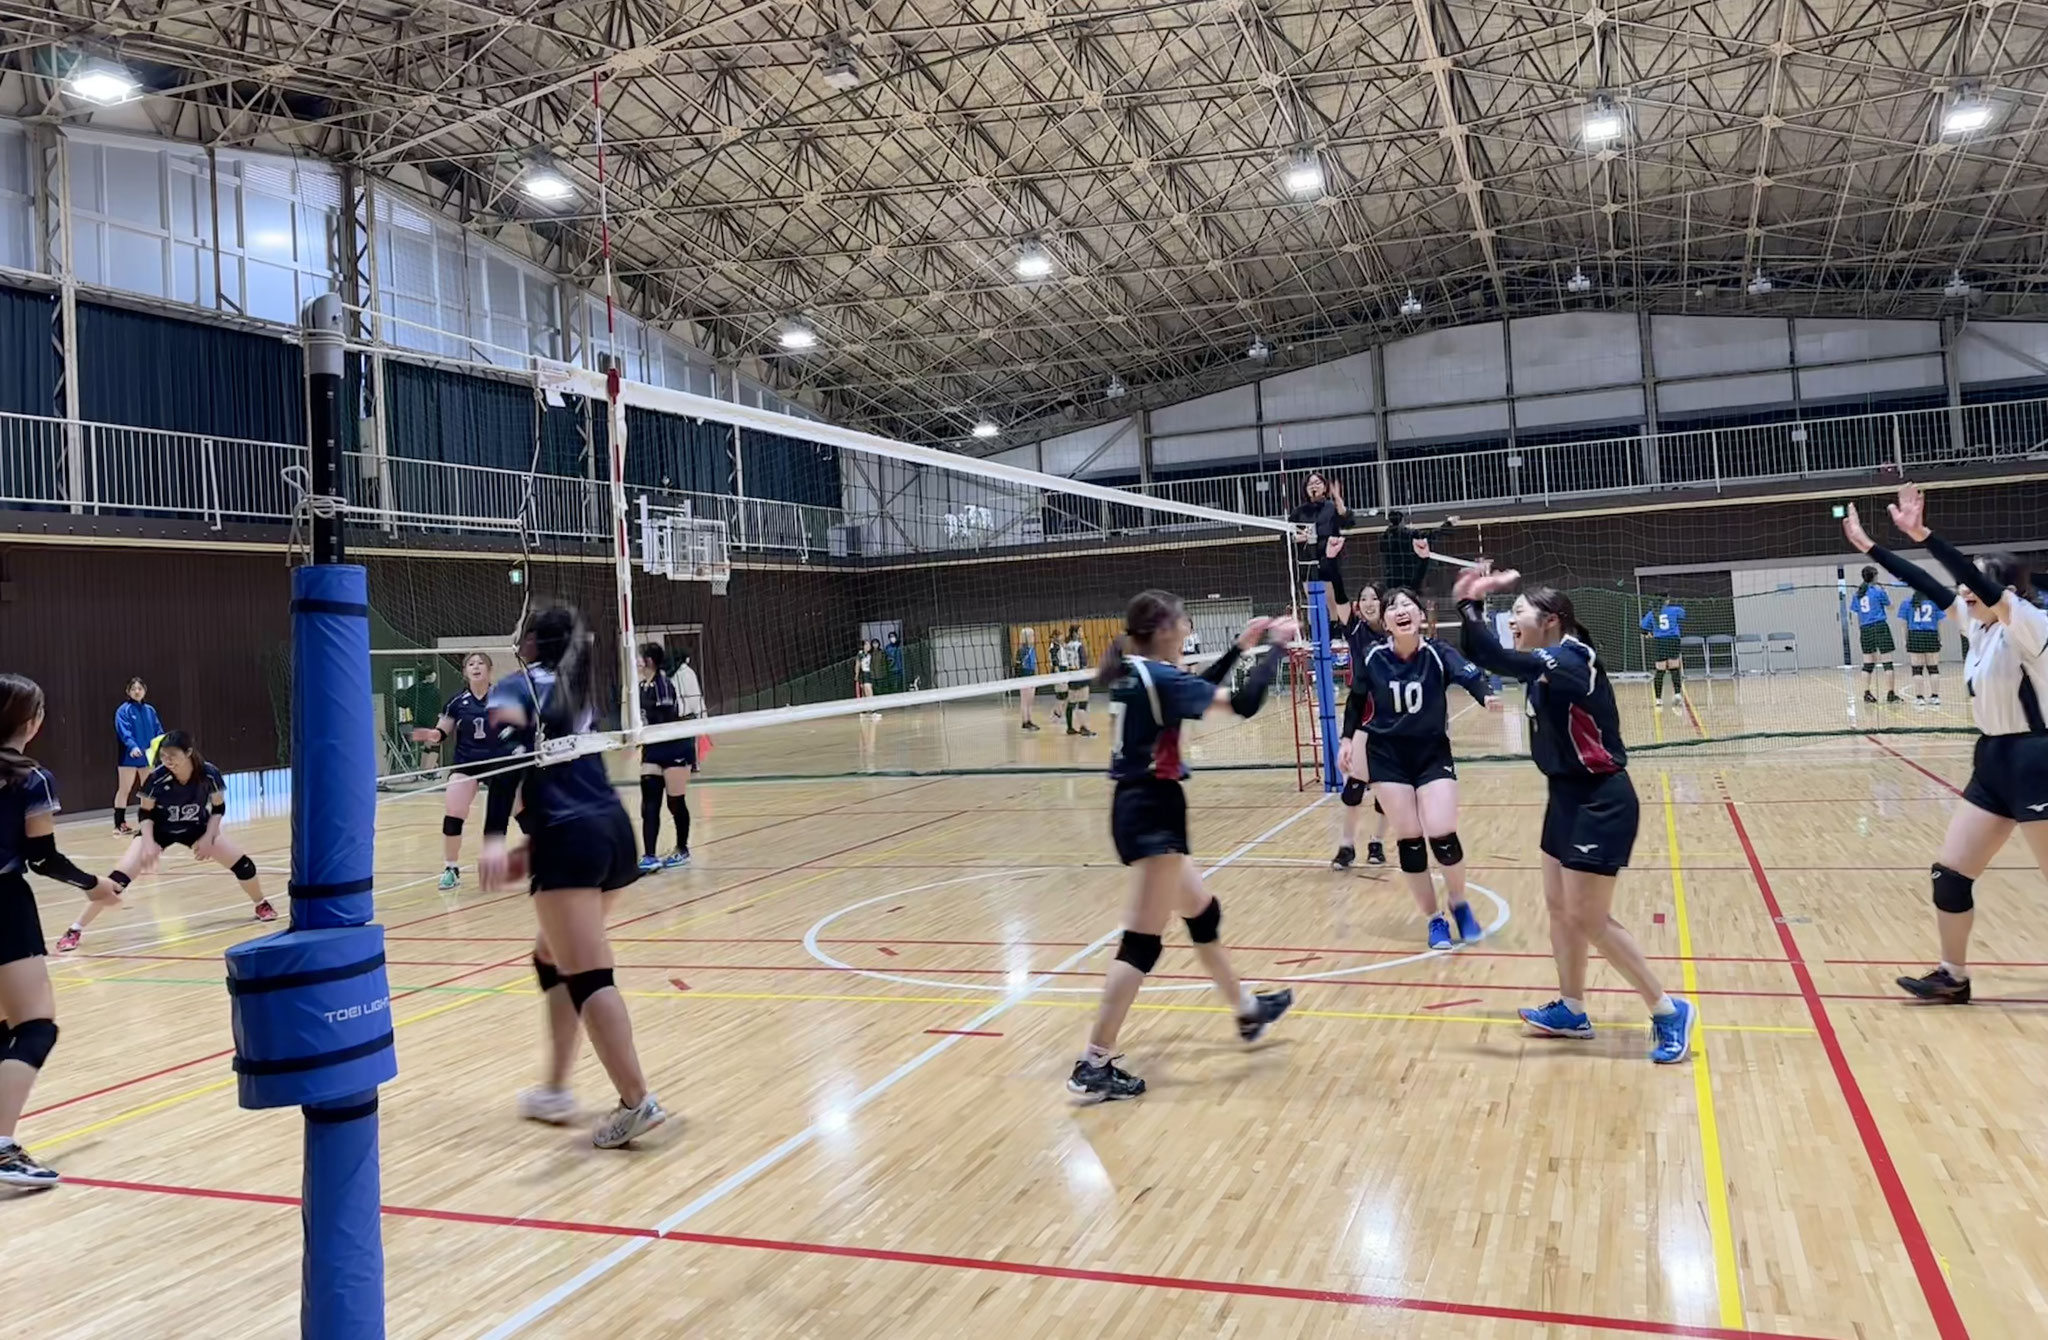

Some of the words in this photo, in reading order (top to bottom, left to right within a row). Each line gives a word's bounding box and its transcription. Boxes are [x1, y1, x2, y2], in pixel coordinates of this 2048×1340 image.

[1860, 595, 1870, 613] 9
[1913, 604, 1932, 622] 12
[1659, 613, 1670, 630] 5
[1388, 680, 1423, 714] 10
[473, 717, 486, 739] 1
[167, 803, 200, 822] 12
[324, 1005, 362, 1023] TOEI
[363, 996, 389, 1014] LIGH
